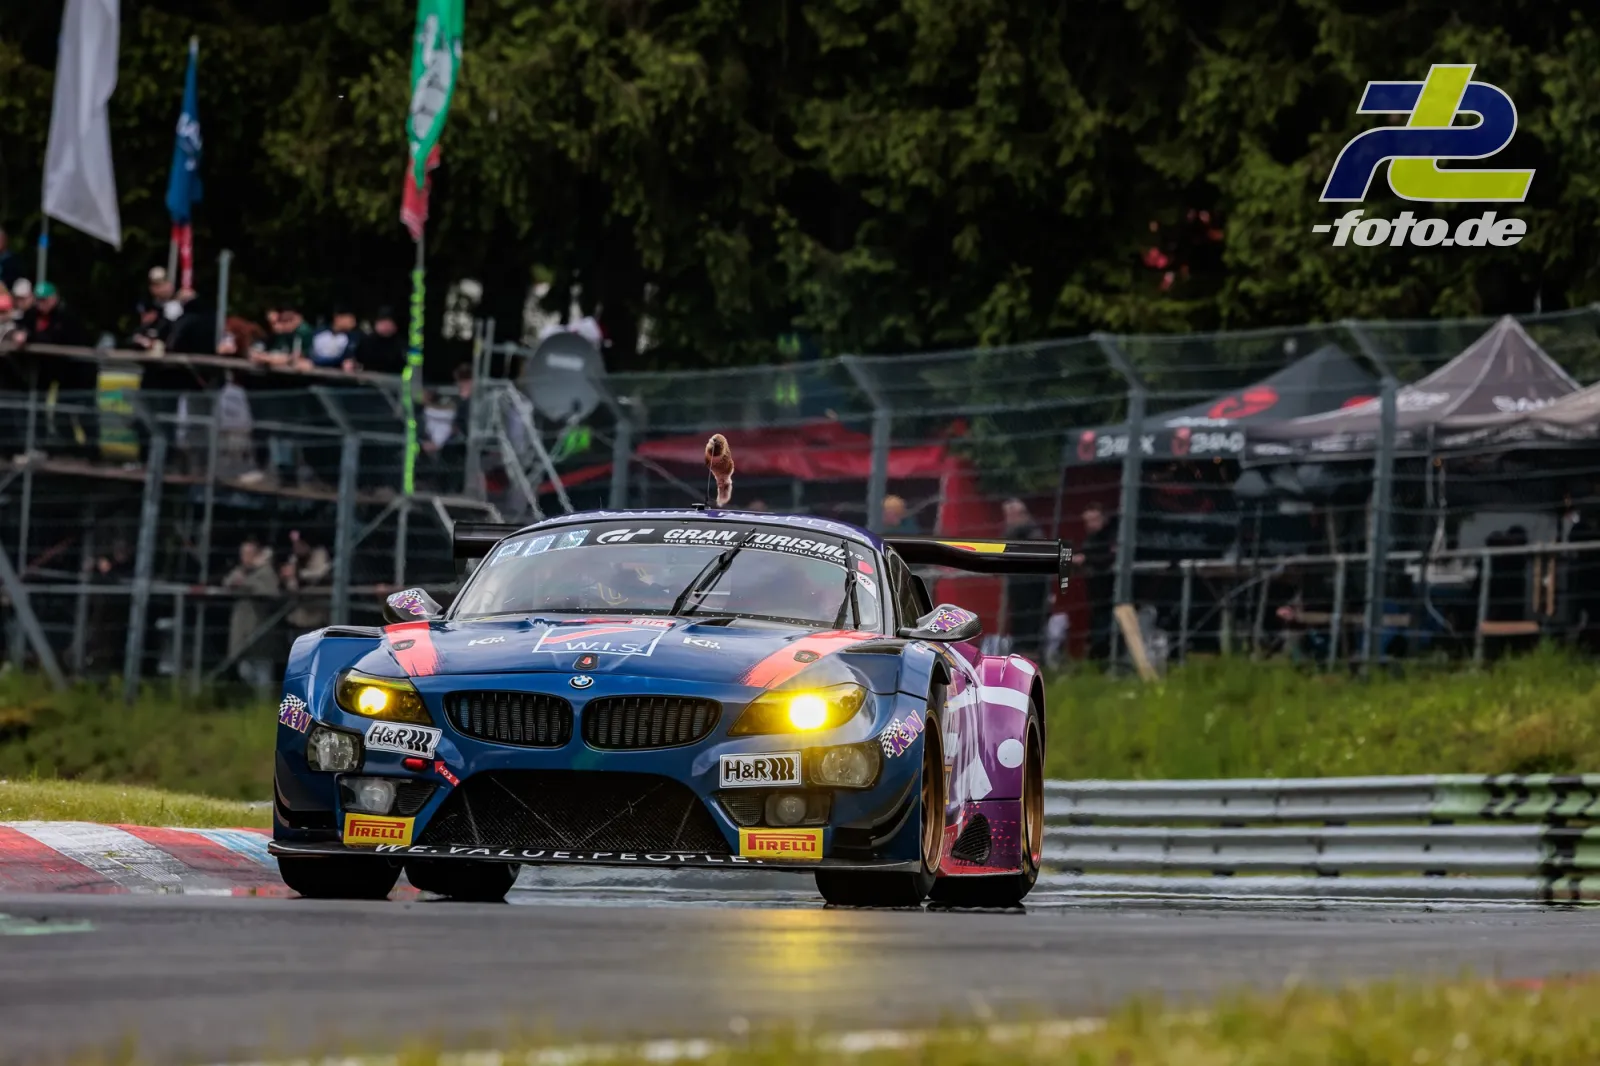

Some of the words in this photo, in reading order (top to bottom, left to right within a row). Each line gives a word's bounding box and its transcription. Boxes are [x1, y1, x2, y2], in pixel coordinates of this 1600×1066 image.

[663, 528, 738, 541] GRAN
[776, 546, 847, 565] SIMULATOR
[280, 704, 313, 734] KW
[369, 725, 409, 749] H&R
[889, 709, 925, 757] KW
[723, 758, 771, 782] H&R
[348, 819, 406, 840] PIRELLI
[747, 832, 817, 852] PIRELLI
